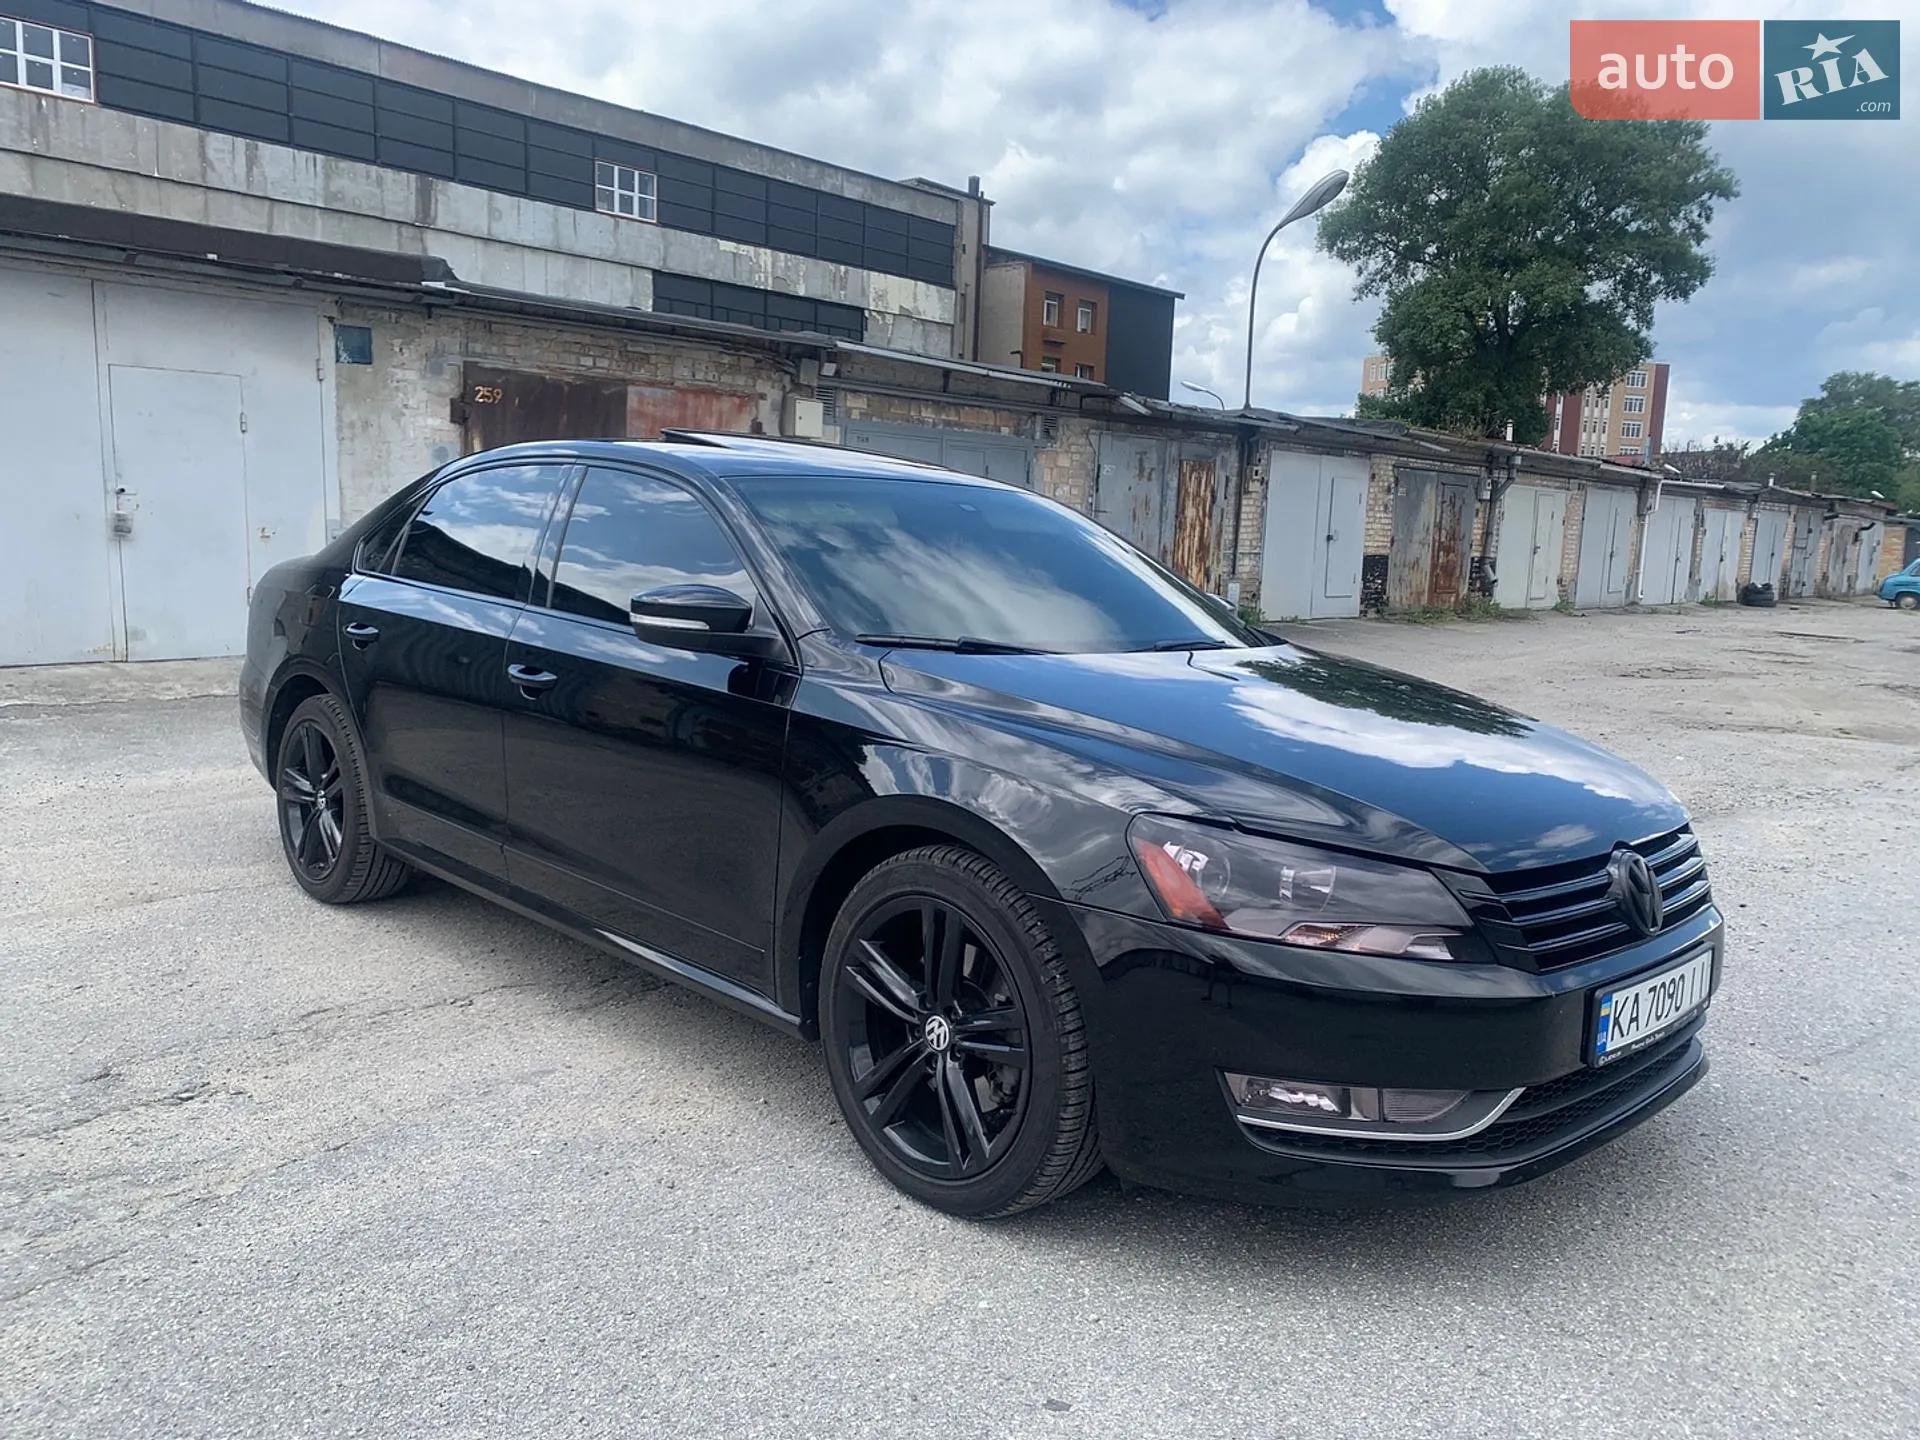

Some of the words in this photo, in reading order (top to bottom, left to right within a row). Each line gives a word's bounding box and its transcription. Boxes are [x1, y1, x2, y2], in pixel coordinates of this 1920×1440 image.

[474, 385, 503, 404] 259
[1610, 991, 1640, 1043] KA
[1644, 972, 1686, 1028] 7090
